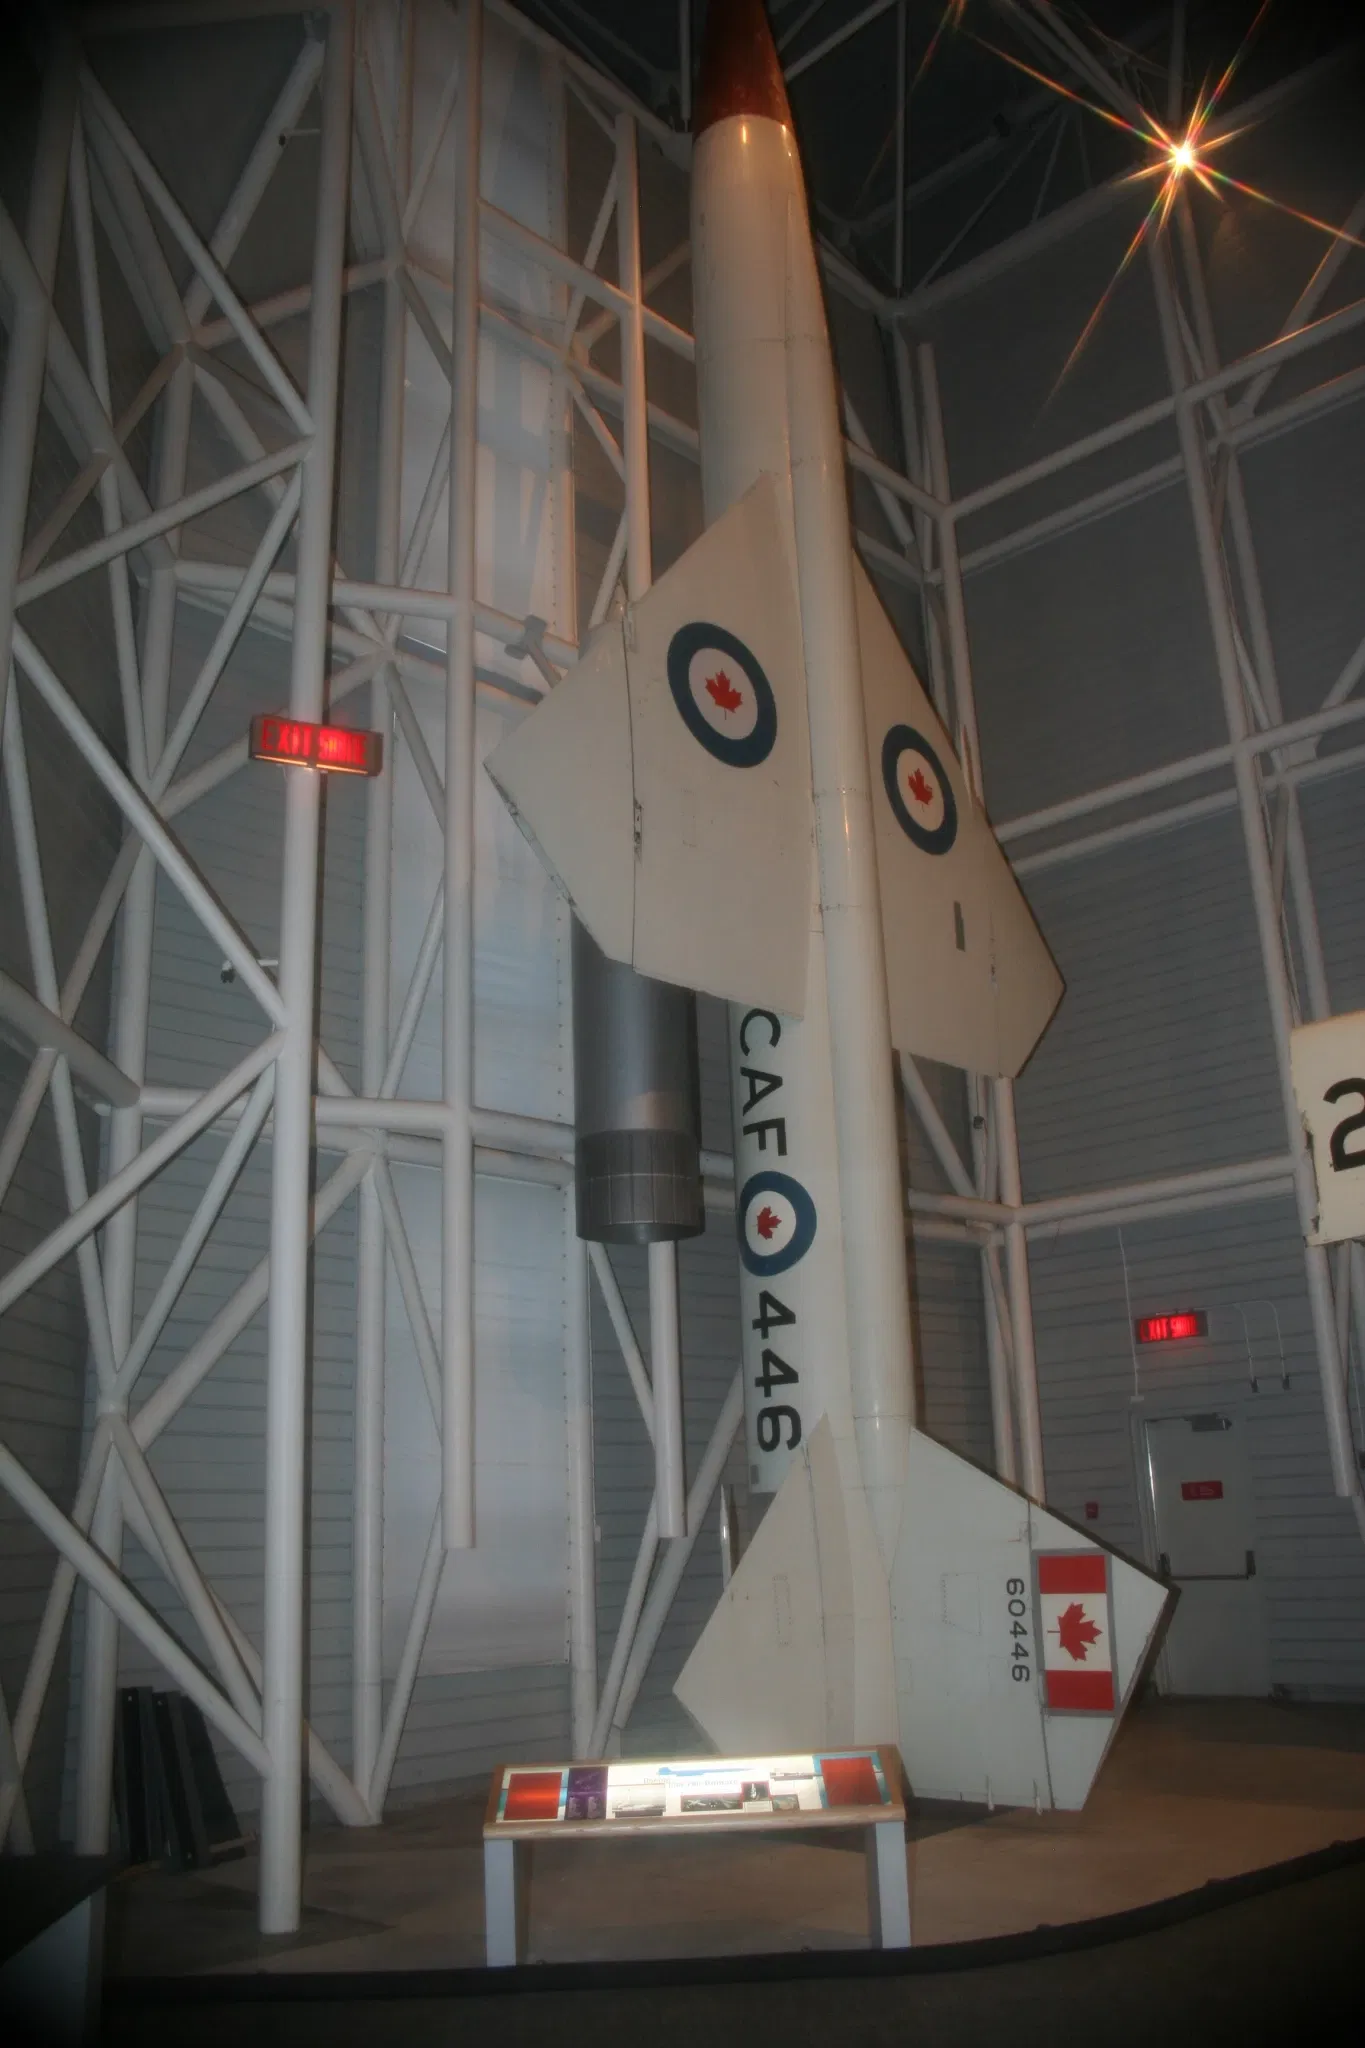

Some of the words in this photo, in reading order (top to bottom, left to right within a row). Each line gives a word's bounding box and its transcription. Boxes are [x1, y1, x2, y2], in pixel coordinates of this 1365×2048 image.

[261, 718, 313, 757] EXIT
[739, 1007, 788, 1157] CAF
[751, 1289, 803, 1453] 446
[1006, 1577, 1030, 1683] 60446
